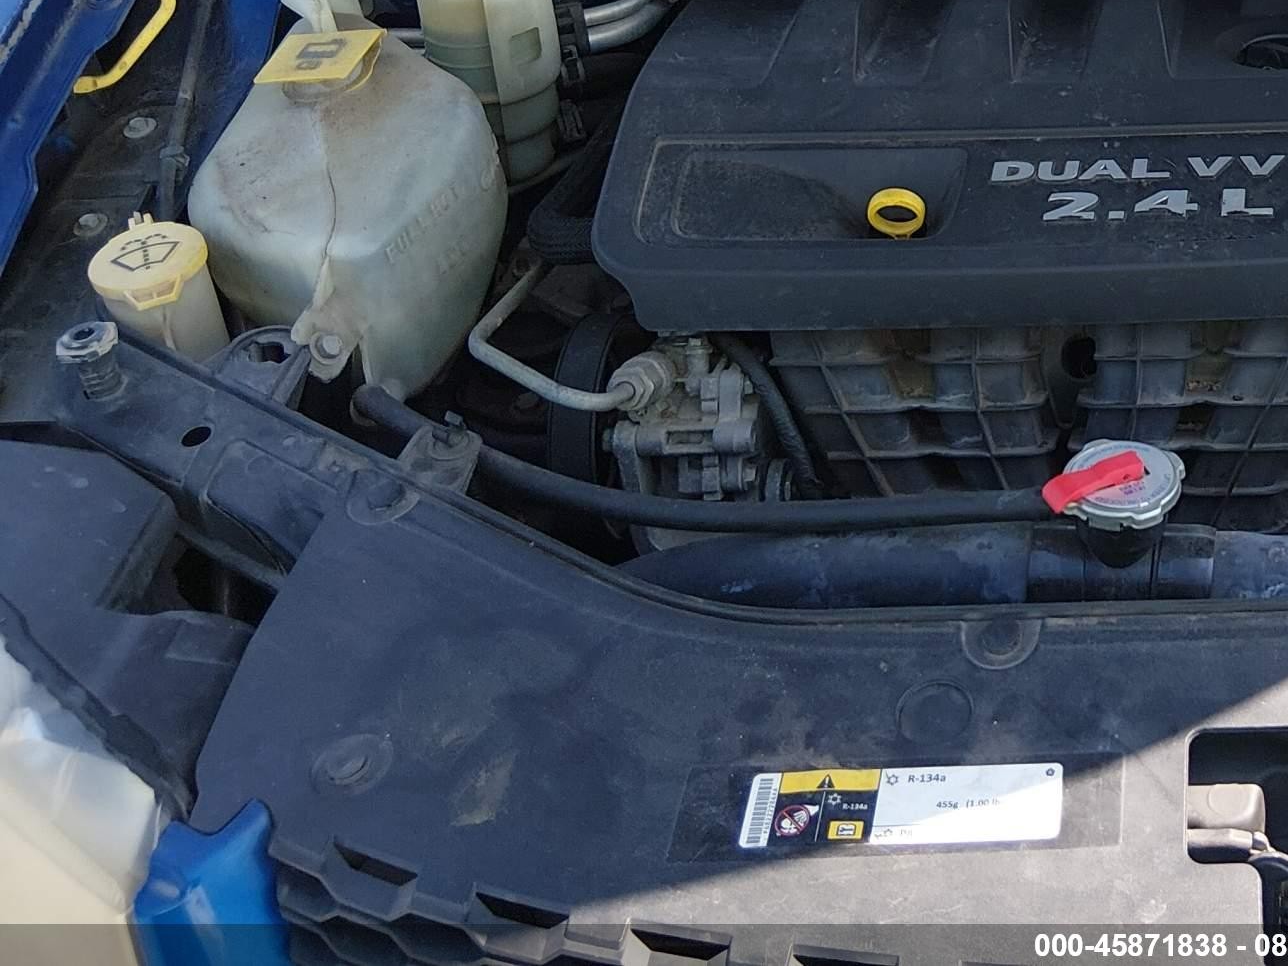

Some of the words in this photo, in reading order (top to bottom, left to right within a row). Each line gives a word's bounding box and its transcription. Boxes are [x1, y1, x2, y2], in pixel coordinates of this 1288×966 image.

[990, 158, 1171, 182] DUAL
[907, 773, 946, 783] R-134a
[936, 800, 959, 809] 455g
